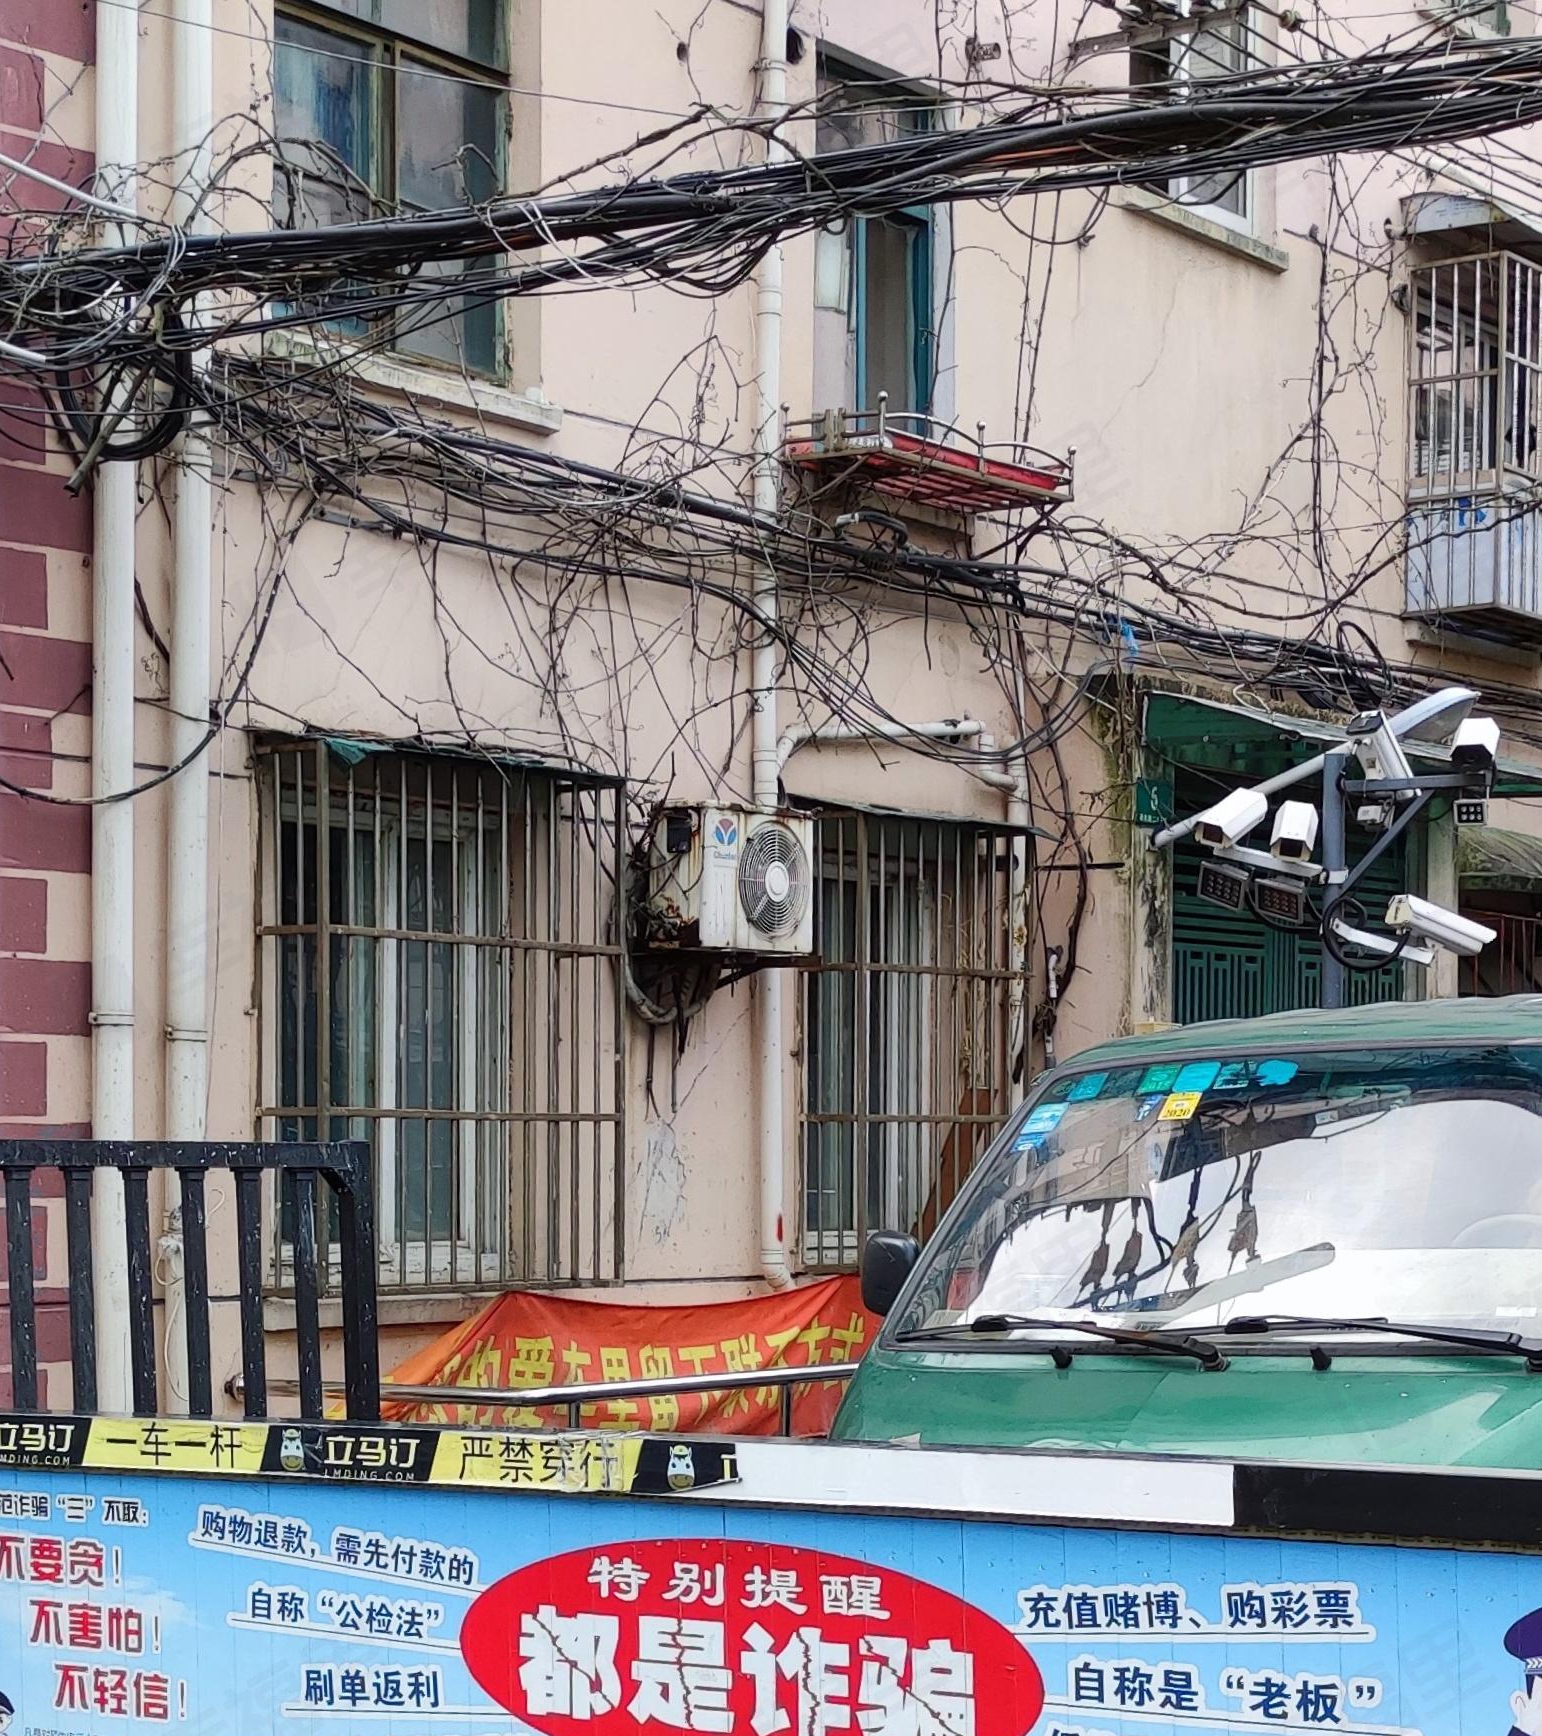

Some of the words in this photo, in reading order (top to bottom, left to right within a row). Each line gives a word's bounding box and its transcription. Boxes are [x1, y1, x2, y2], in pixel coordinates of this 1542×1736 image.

[106, 1422, 243, 1468] 一车一杆
[324, 1435, 420, 1468] 立马订
[201, 1509, 474, 1586] 购物退款，需先付款的
[586, 1555, 891, 1621] 特别提醒
[1024, 1588, 1355, 1630] 充值赌博、购彩票
[303, 1668, 440, 1708] 刷单返利
